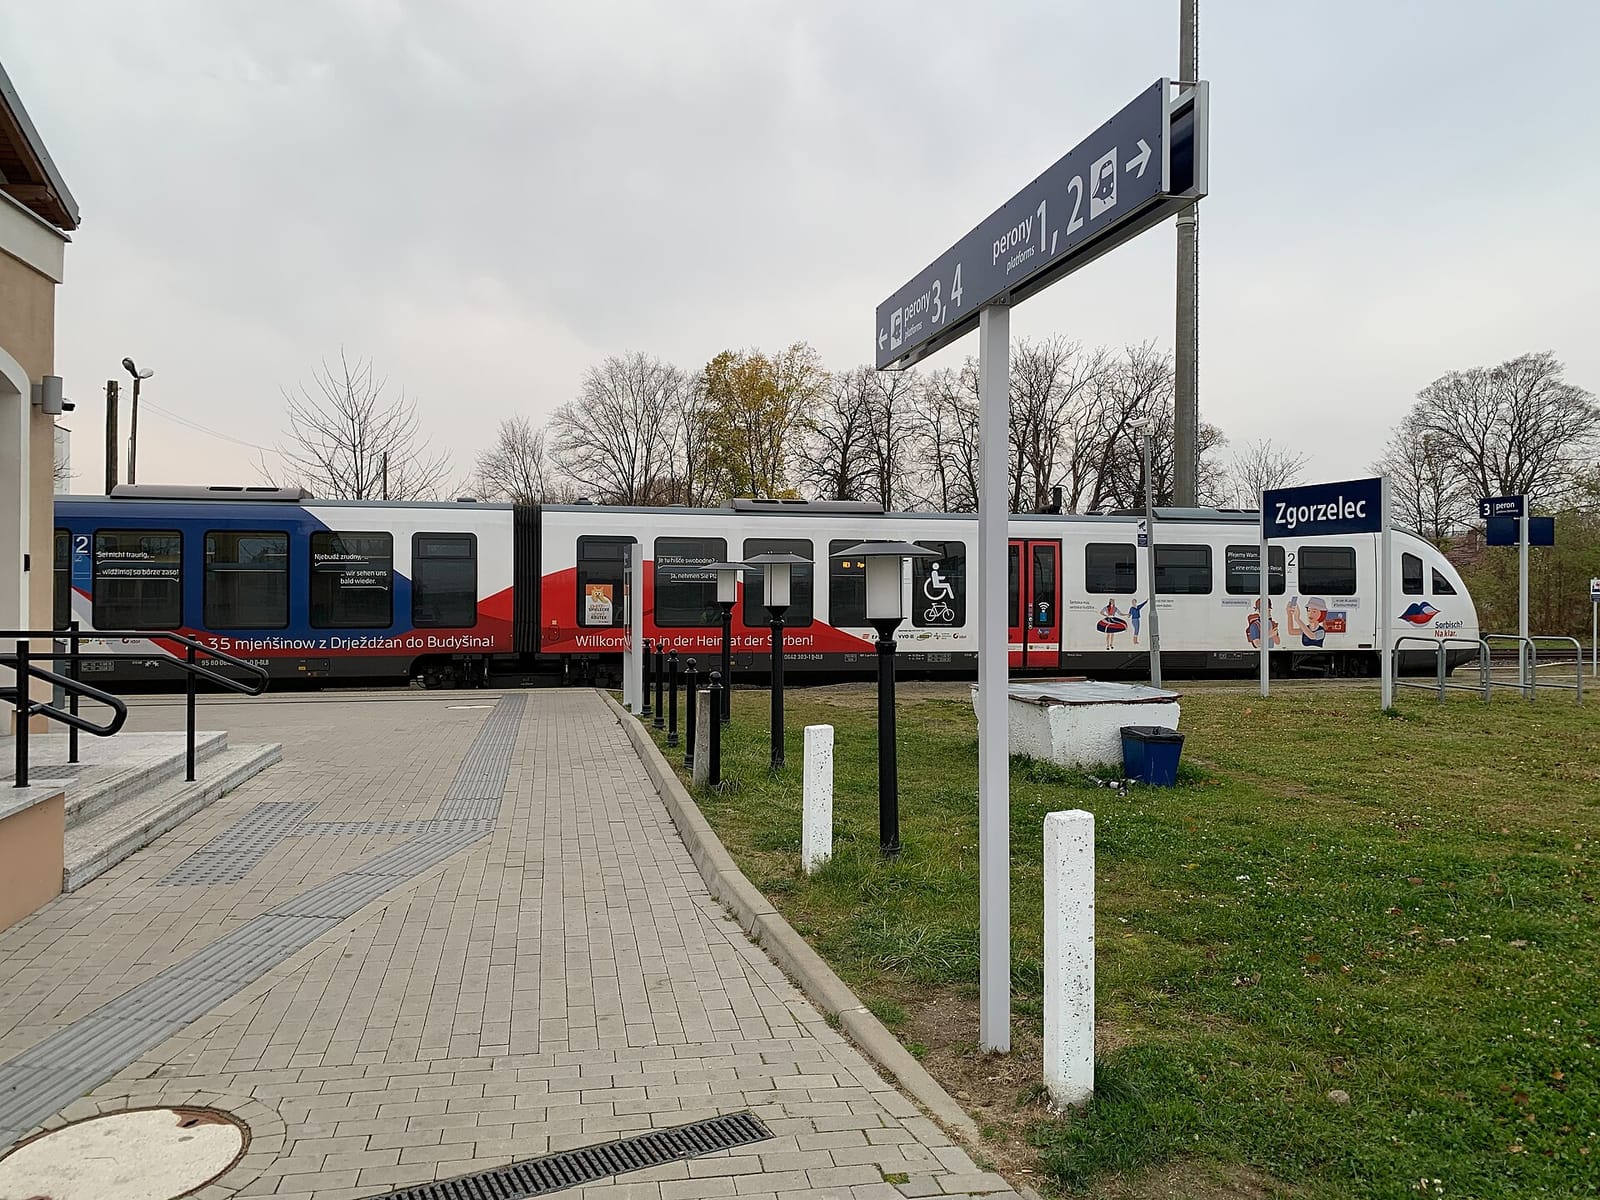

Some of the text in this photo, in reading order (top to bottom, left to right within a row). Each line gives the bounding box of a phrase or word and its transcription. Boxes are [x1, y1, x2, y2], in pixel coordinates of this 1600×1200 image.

[992, 174, 1084, 266] perony 1, 2
[1006, 244, 1036, 276] platforms
[904, 263, 964, 328] perony 3, 4
[1275, 495, 1367, 529] Zgorzelec
[1483, 503, 1491, 516] 3
[1495, 502, 1515, 511] peron
[75, 536, 89, 554] 2
[1287, 552, 1296, 567] 2
[1435, 620, 1463, 629] Sorbisch?
[208, 637, 231, 651] 35
[319, 638, 327, 649] z
[405, 636, 424, 649] do
[427, 635, 495, 650] Budyšina!
[659, 635, 670, 647] in
[673, 635, 694, 647] der
[744, 635, 763, 647] der
[767, 634, 814, 647] Srben!
